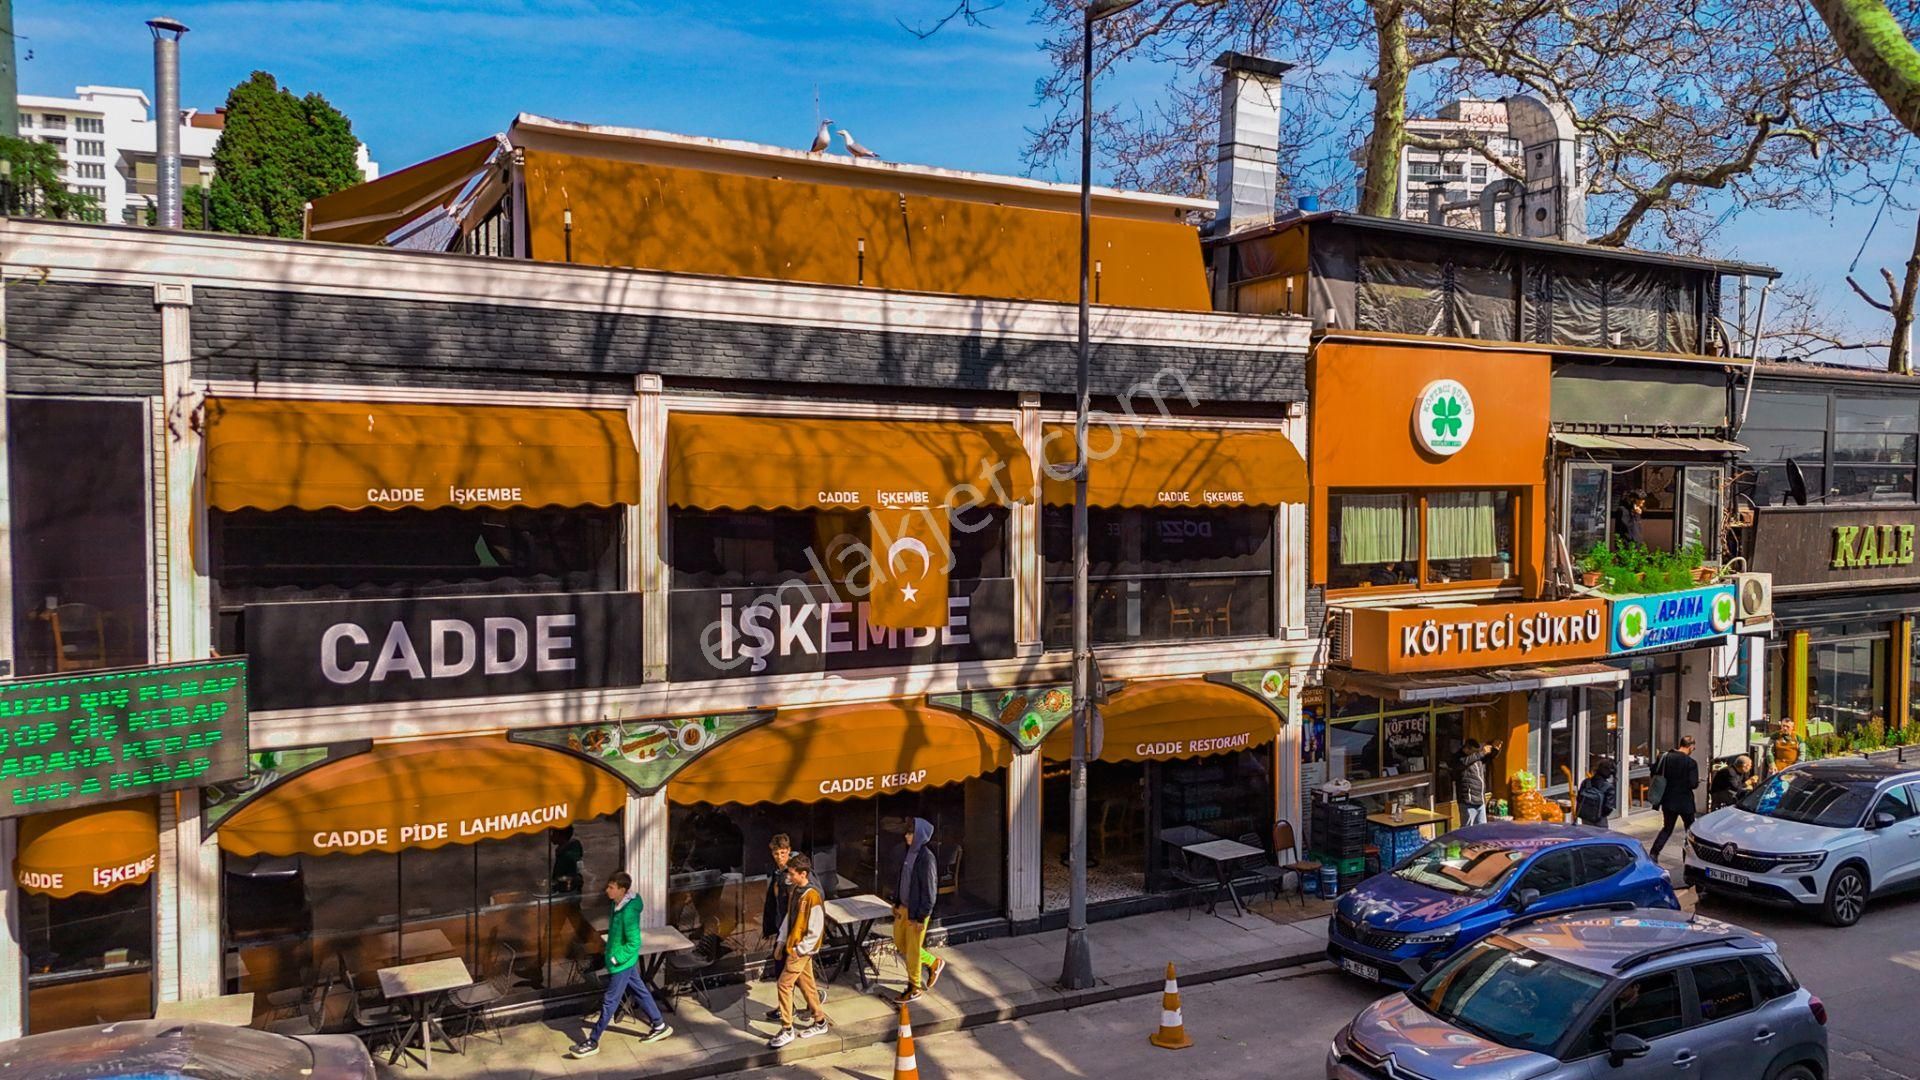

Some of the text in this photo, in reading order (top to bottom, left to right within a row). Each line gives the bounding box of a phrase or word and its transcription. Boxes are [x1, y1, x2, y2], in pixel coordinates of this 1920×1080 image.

[367, 485, 522, 504] CADDE İŞKEMBE
[818, 489, 929, 506] CADDE İŞKEMBE
[1158, 489, 1244, 504] CADDE İŞKEMBE
[1832, 524, 1915, 567] KALE
[1657, 595, 1703, 622] ADANA
[1403, 613, 1514, 655] KÖFTECİ
[1520, 608, 1600, 652] ŞÜKRÜ
[320, 613, 576, 684] CADDE
[1136, 732, 1250, 755] CADDE RESTORANT
[819, 769, 926, 794] CADDE KEBAP
[313, 803, 568, 848] CADDE PİDE LAHMACUN
